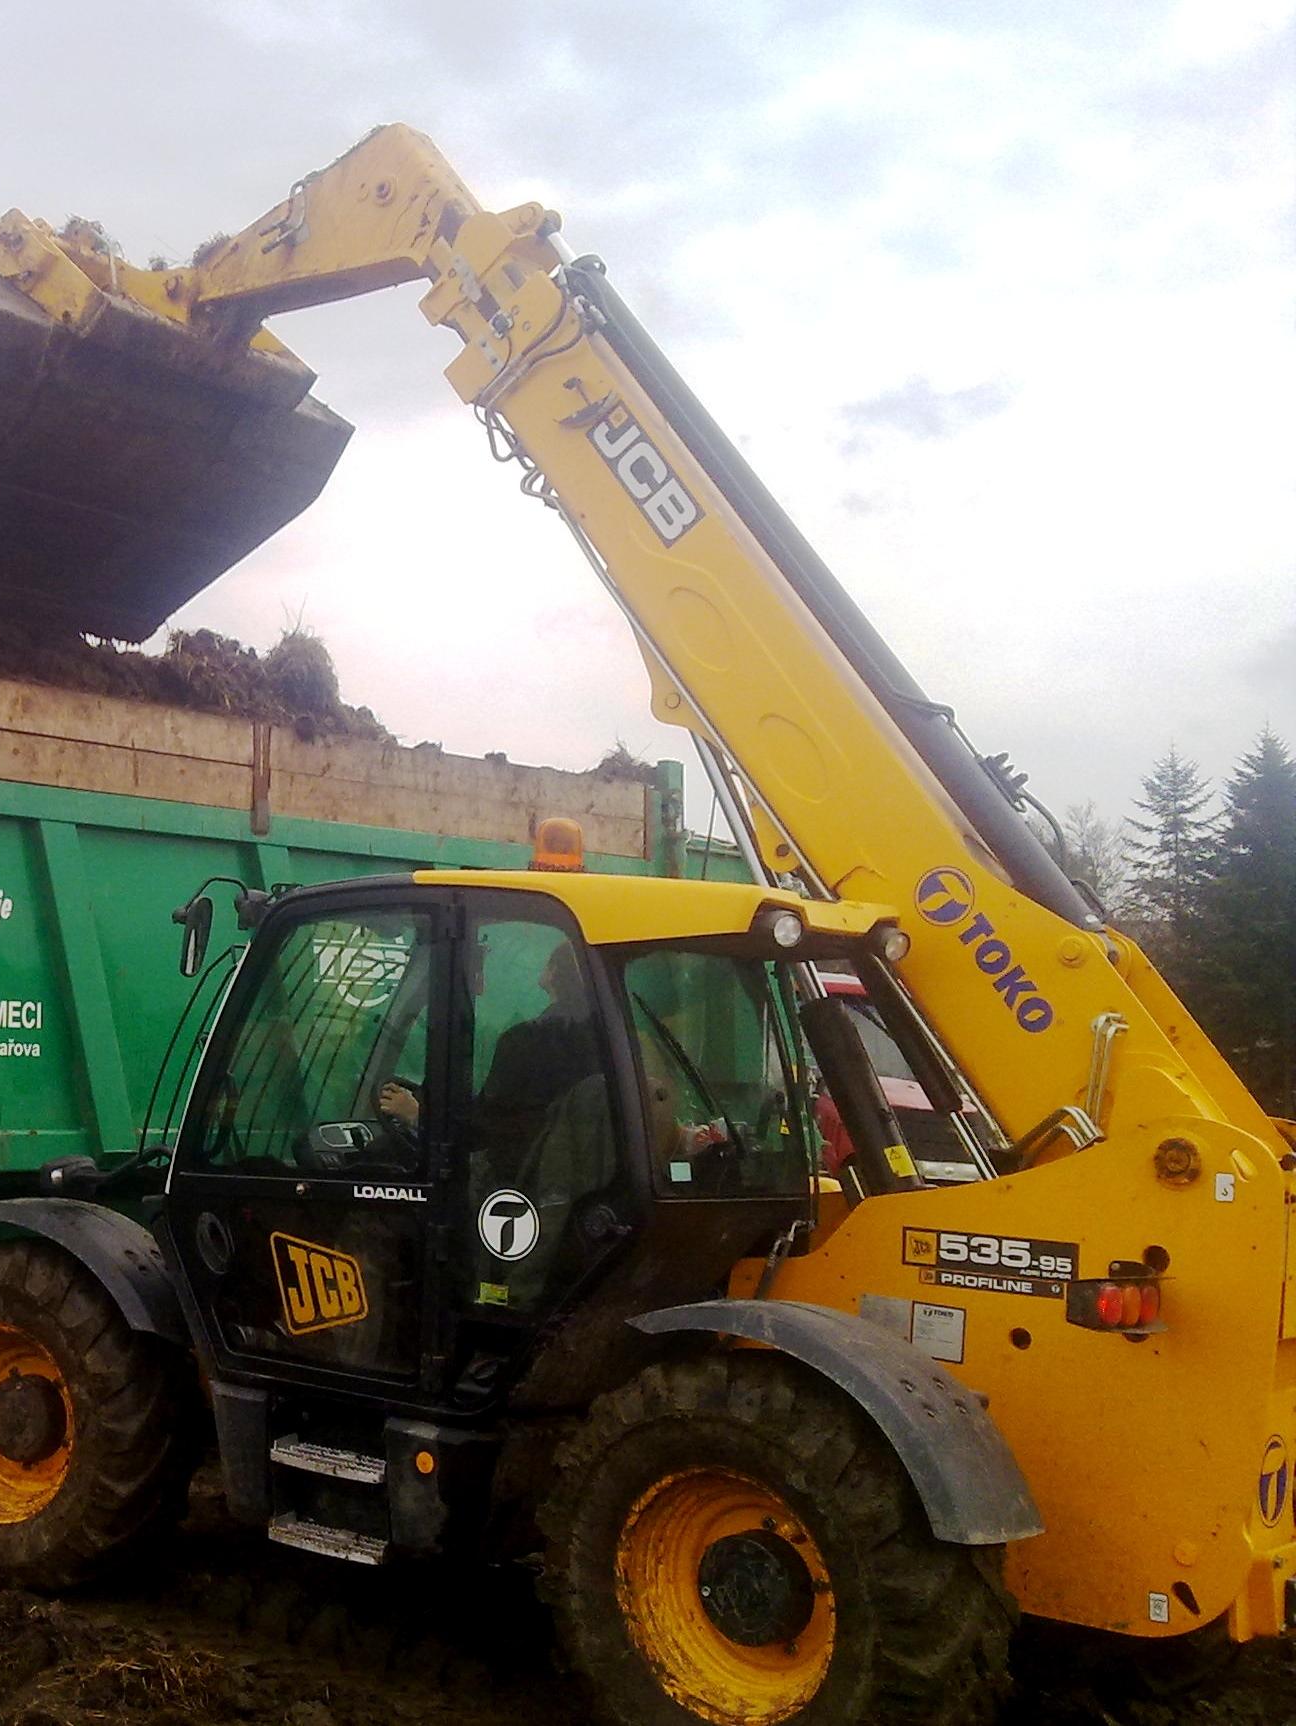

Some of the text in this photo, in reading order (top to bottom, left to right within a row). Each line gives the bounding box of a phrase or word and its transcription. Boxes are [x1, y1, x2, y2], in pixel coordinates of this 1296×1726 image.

[593, 421, 697, 540] JCB
[958, 912, 1053, 1033] TOKO
[354, 1185, 428, 1202] LOADALL
[286, 1243, 361, 1324] JCB
[940, 1272, 1033, 1294] PROFILINE
